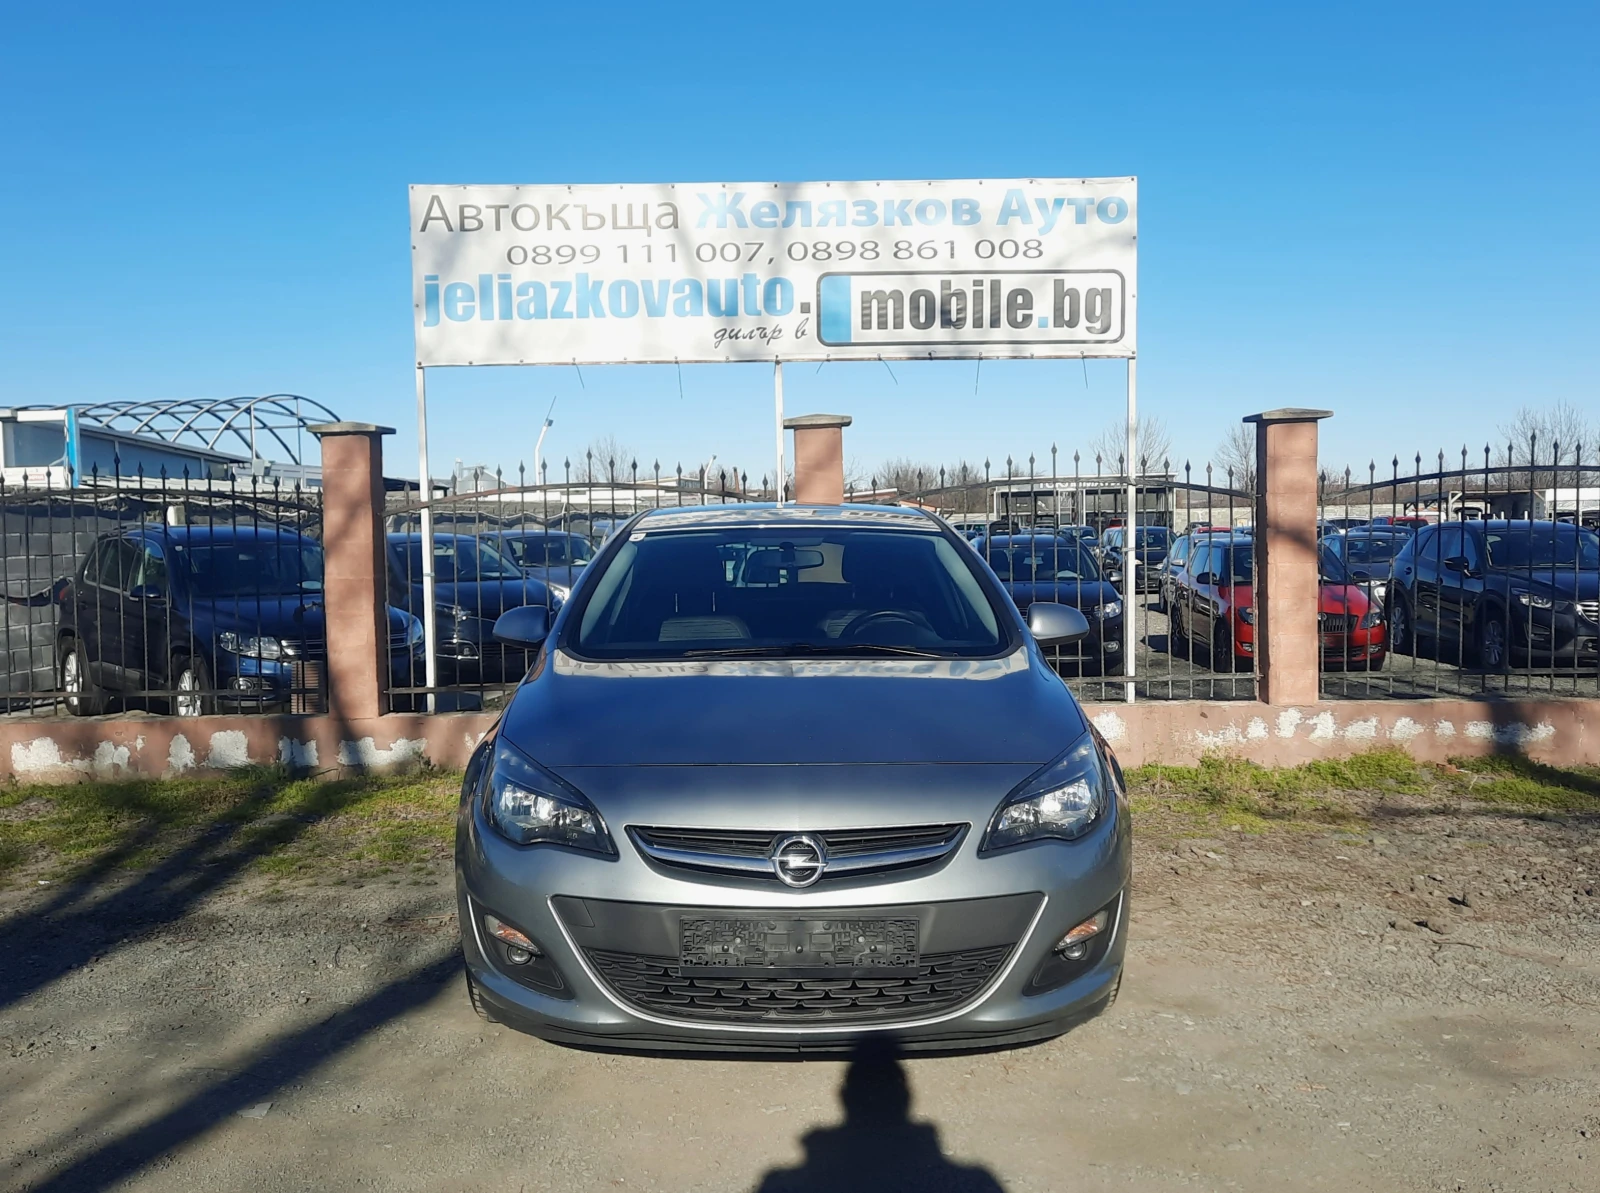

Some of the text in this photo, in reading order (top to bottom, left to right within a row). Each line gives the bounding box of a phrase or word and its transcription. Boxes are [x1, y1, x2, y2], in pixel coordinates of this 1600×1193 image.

[419, 188, 1129, 237] Автокъща Желязков Ауто
[506, 239, 1044, 265] 0899 111 007, 0898 861 008
[860, 278, 1114, 335] mobile.bg
